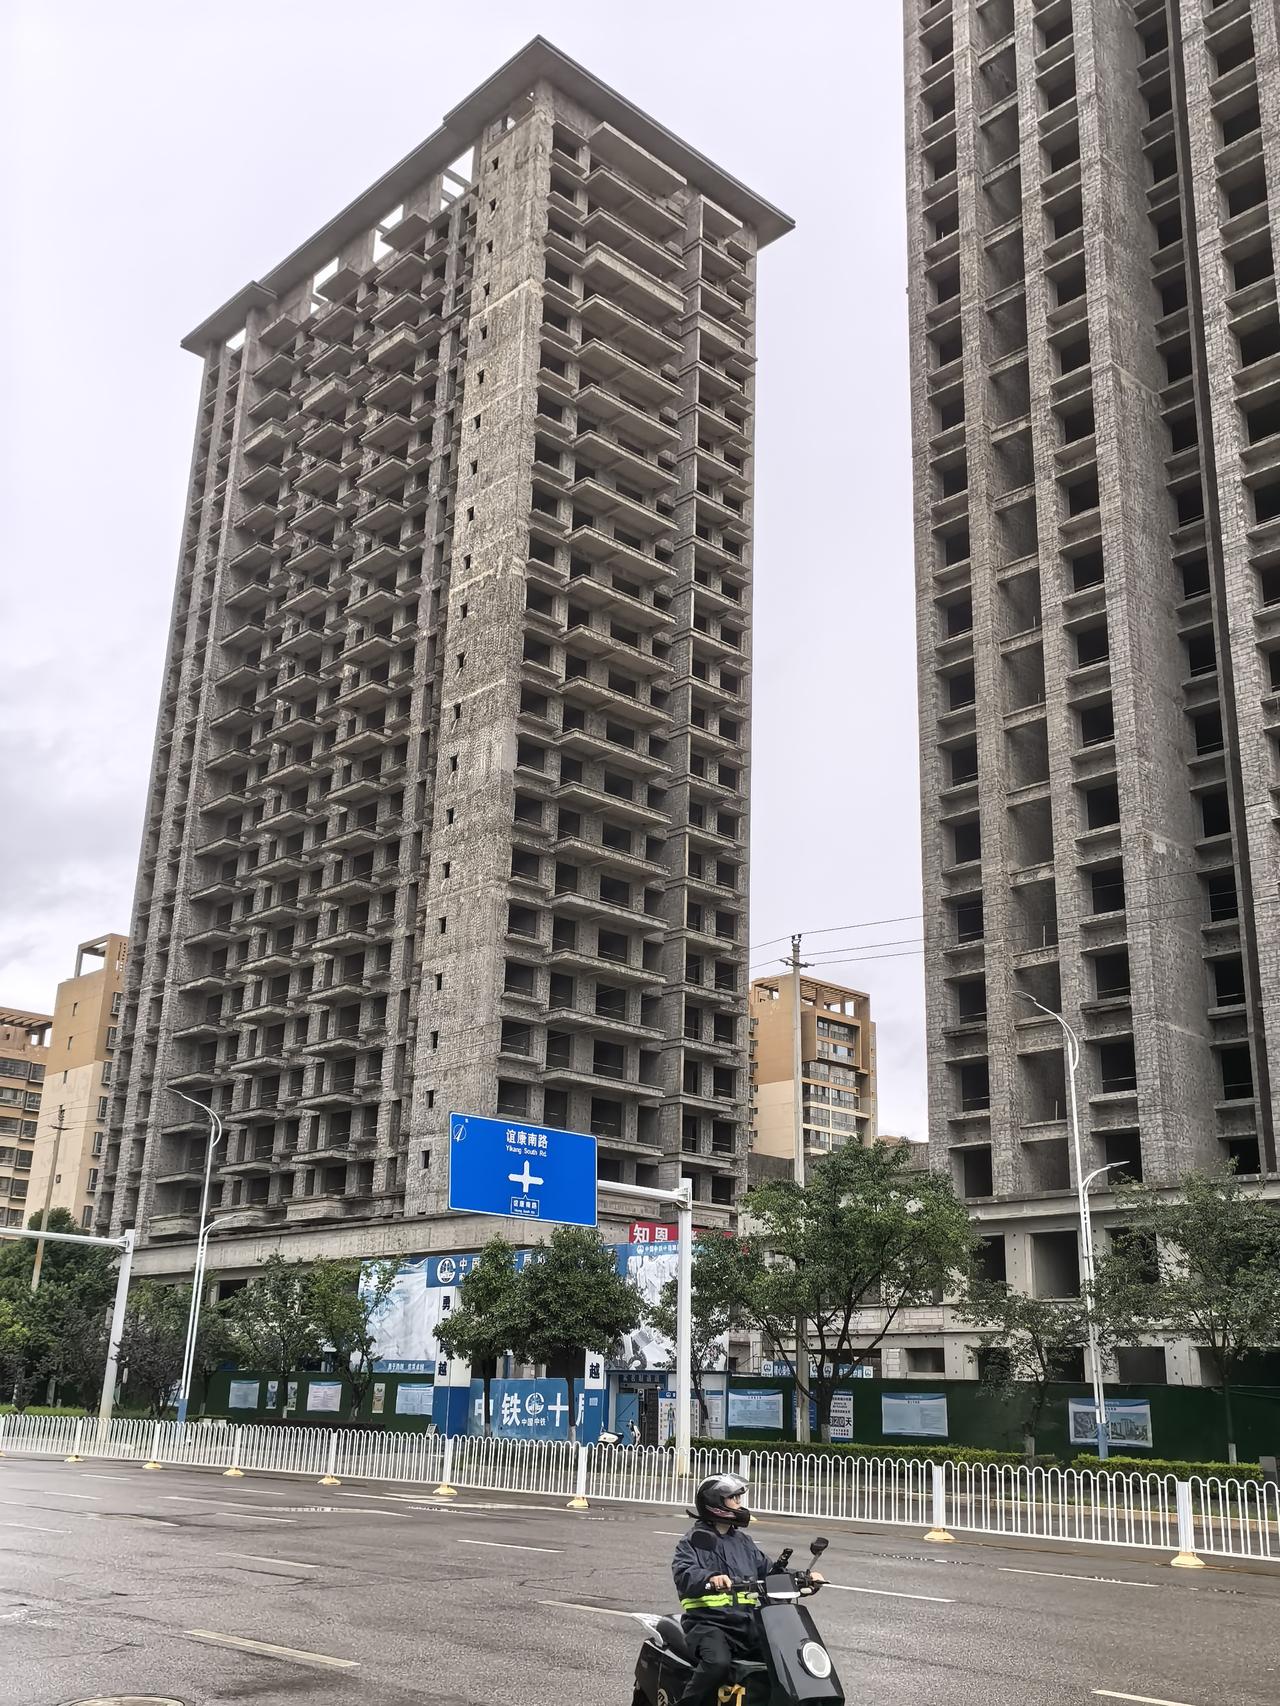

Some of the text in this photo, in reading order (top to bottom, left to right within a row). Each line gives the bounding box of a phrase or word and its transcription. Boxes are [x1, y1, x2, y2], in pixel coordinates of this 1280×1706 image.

[506, 1129, 548, 1149] 谊康南路
[506, 1145, 522, 1155] Yikang
[524, 1147, 538, 1156] South
[521, 1417, 546, 1427] 中国中铁
